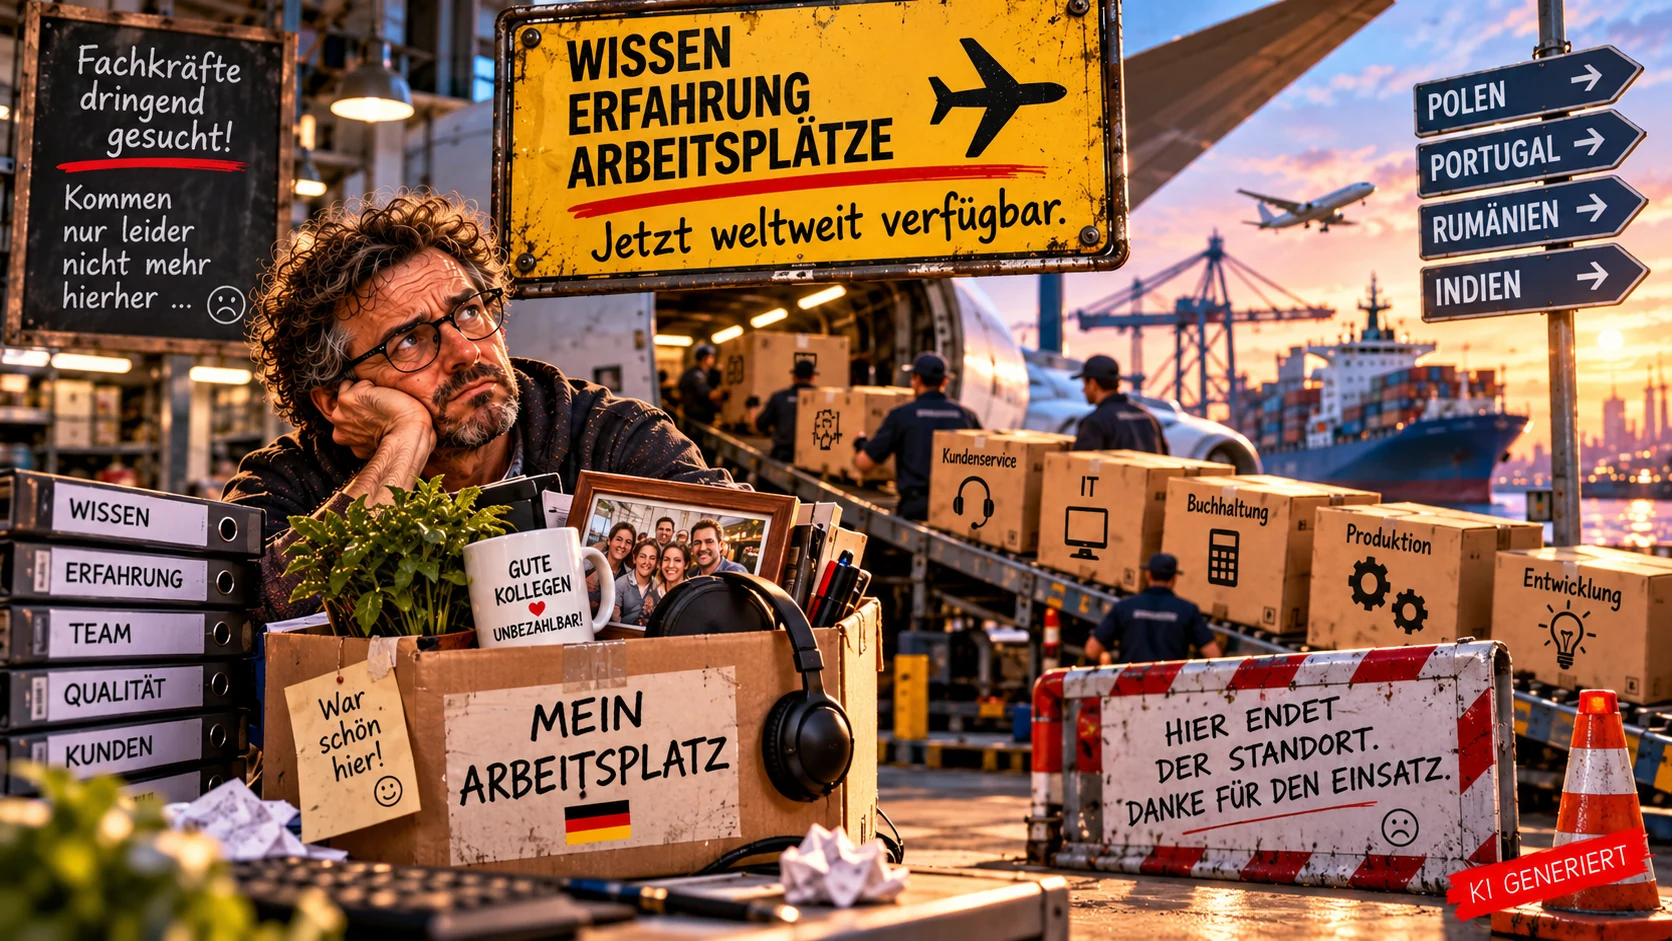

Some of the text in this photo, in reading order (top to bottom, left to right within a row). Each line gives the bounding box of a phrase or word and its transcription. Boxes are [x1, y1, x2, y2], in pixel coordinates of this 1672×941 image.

[77, 44, 241, 83] Fachkräfte
[567, 26, 731, 83] WISSEN
[80, 80, 204, 122] dringend
[569, 72, 810, 136] ERFAHRUNG
[1428, 80, 1506, 120] POLEN
[107, 120, 233, 158] gesucht!
[567, 117, 894, 189] ARBEITSPLÄTZE
[1431, 135, 1560, 181] PORTUGAL
[64, 184, 172, 211] Kommen
[63, 216, 194, 243] nur leider
[591, 188, 1066, 263] Jetzt weltweit verfügbar.
[1433, 200, 1559, 243] RUMÄNIEN
[63, 248, 211, 276] nicht mehr
[63, 282, 158, 309] hierher
[1436, 270, 1521, 306] INDIEN
[942, 447, 1017, 469] Kundenservice
[1081, 476, 1099, 497] IT
[69, 498, 150, 528] WISSEN
[1187, 493, 1269, 526] Buchhaltung
[1346, 524, 1432, 555] Produktion
[66, 562, 183, 588] ERFAHRUNG
[509, 554, 552, 579] GUTE
[495, 575, 572, 606] KOLLEGEN
[1523, 567, 1621, 612] Entwicklung
[69, 623, 131, 644] TEAM
[493, 611, 583, 642] UNBEZAHLBAR!
[64, 674, 166, 707] QUALITÄT
[318, 691, 365, 721] War
[530, 691, 644, 742] MEIN
[1165, 696, 1340, 747] HIER ENDET
[66, 736, 153, 768] KUNDEN
[320, 717, 381, 754] schön
[332, 742, 382, 782] hier!
[460, 736, 730, 805] ARBEITSPLATZ
[1156, 727, 1379, 784] DER STANDORT.
[1125, 756, 1451, 827] DANKE FÜR DEN EINSATZ.
